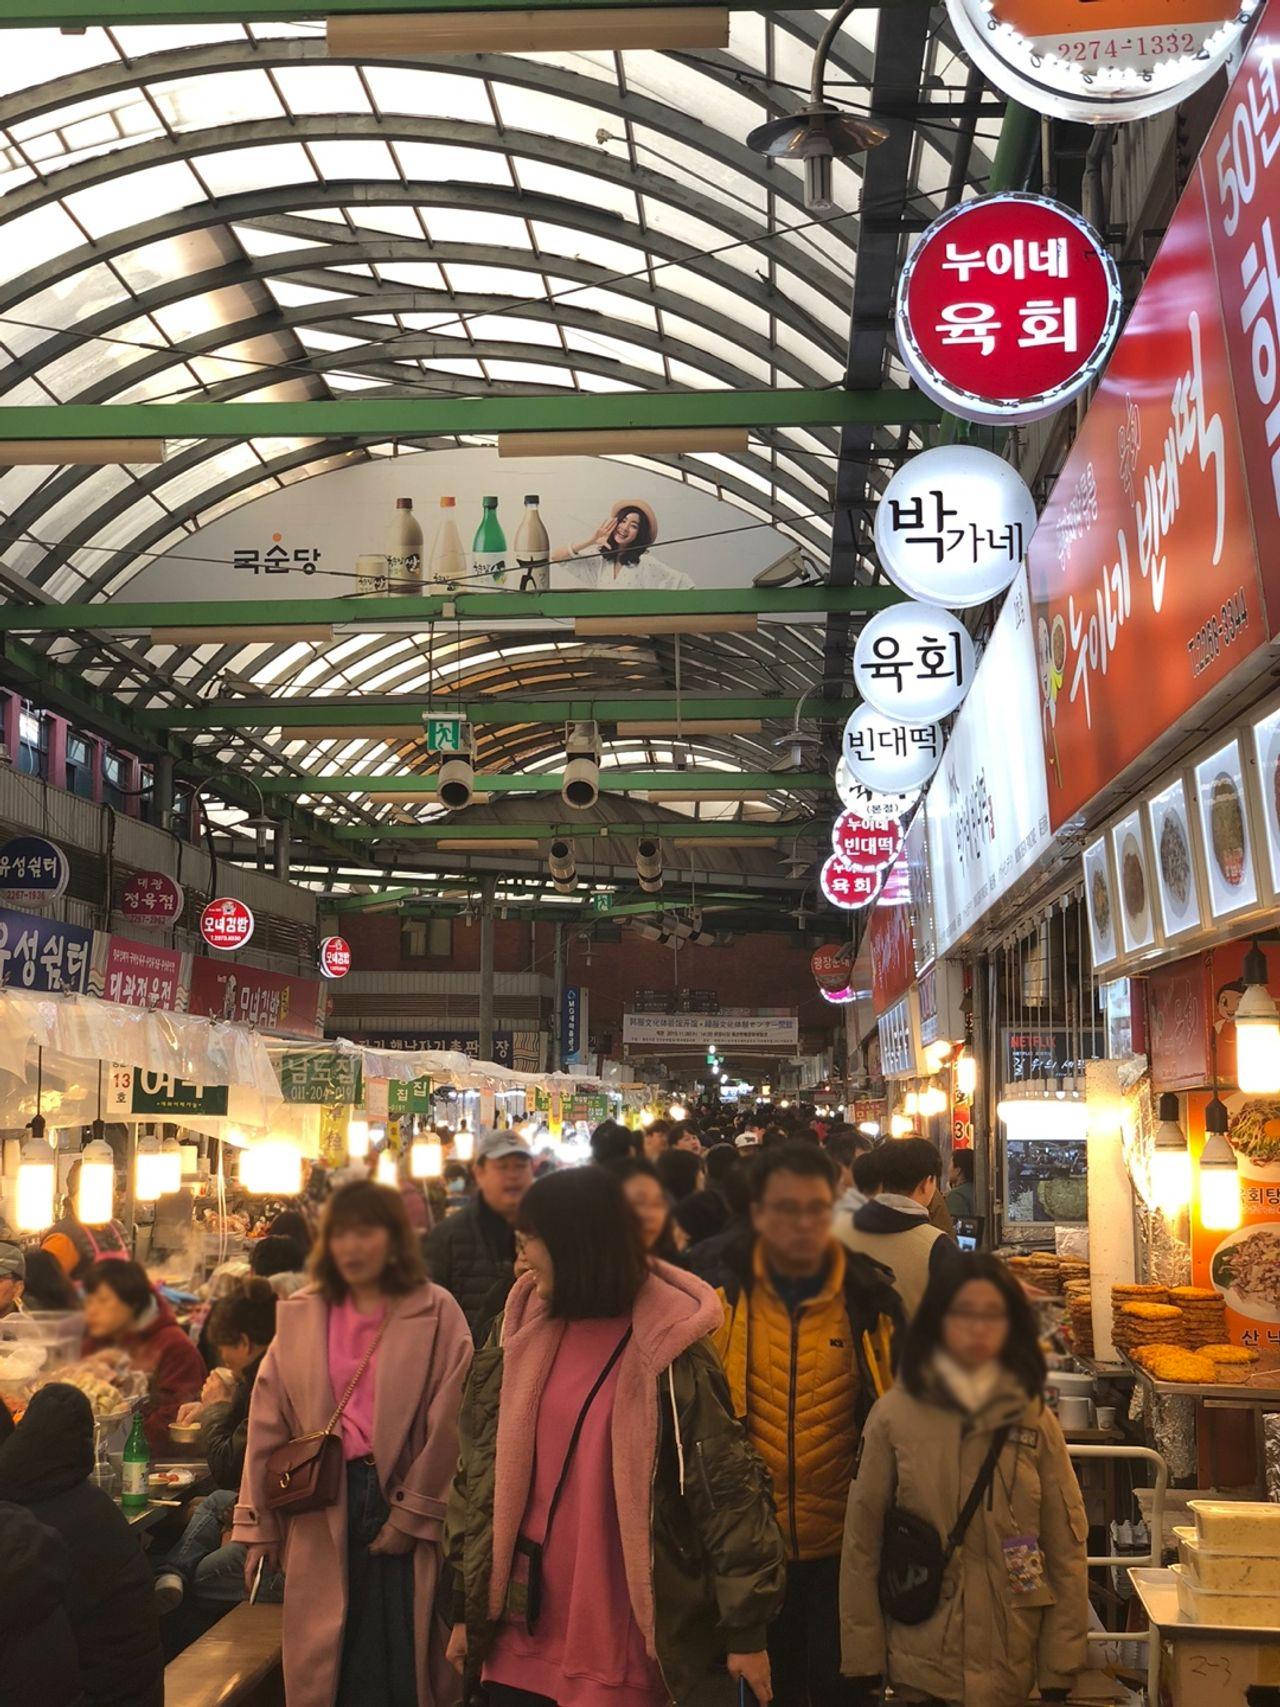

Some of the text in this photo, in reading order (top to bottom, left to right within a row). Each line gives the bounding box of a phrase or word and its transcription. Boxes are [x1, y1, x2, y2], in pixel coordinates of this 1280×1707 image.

[1057, 33, 1195, 61] 2274-1332
[941, 237, 1069, 282] 누이네
[888, 490, 1023, 563] 박가네
[233, 544, 321, 575] 국순당
[860, 631, 963, 693] 육회
[847, 725, 937, 761] 빈대떡
[844, 837, 893, 855] 빈대떡
[124, 892, 174, 911] 정육점
[113, 1073, 131, 1088] 13
